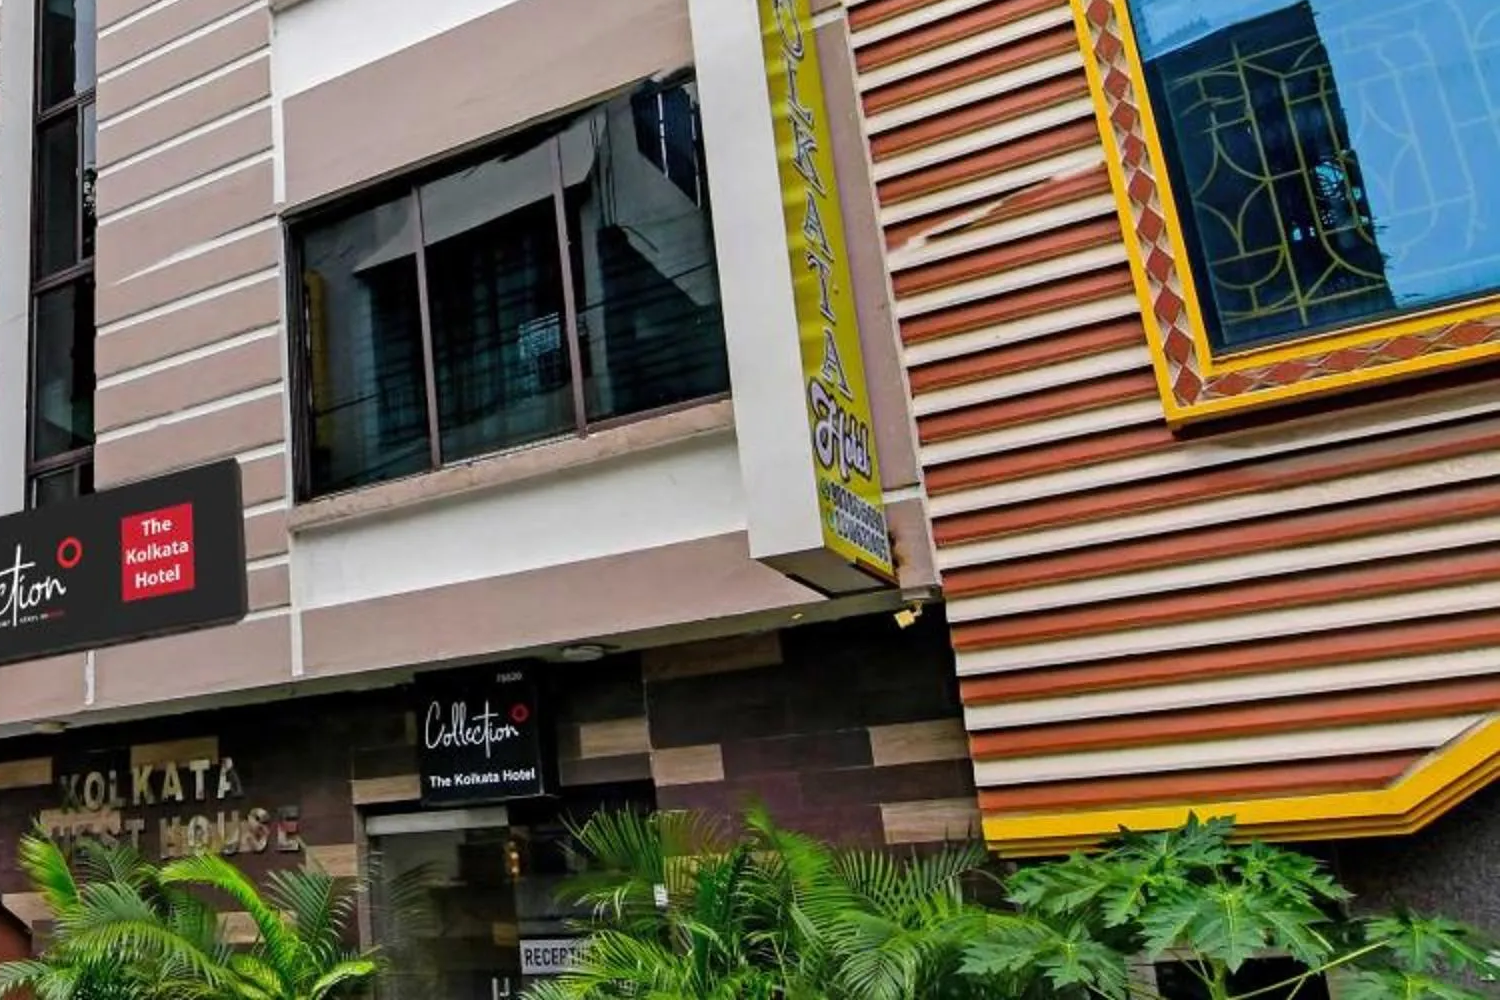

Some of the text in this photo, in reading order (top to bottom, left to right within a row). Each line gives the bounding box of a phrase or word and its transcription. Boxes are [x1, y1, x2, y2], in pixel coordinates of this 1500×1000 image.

[808, 376, 872, 483] Hotel
[141, 516, 173, 538] The
[124, 538, 190, 566] Kolkata
[134, 565, 182, 590] Hotel
[425, 699, 519, 759] Collection
[60, 757, 243, 813] KOLKATA
[429, 767, 536, 788] The Kolkata Hotel
[159, 803, 300, 859] HOUSE
